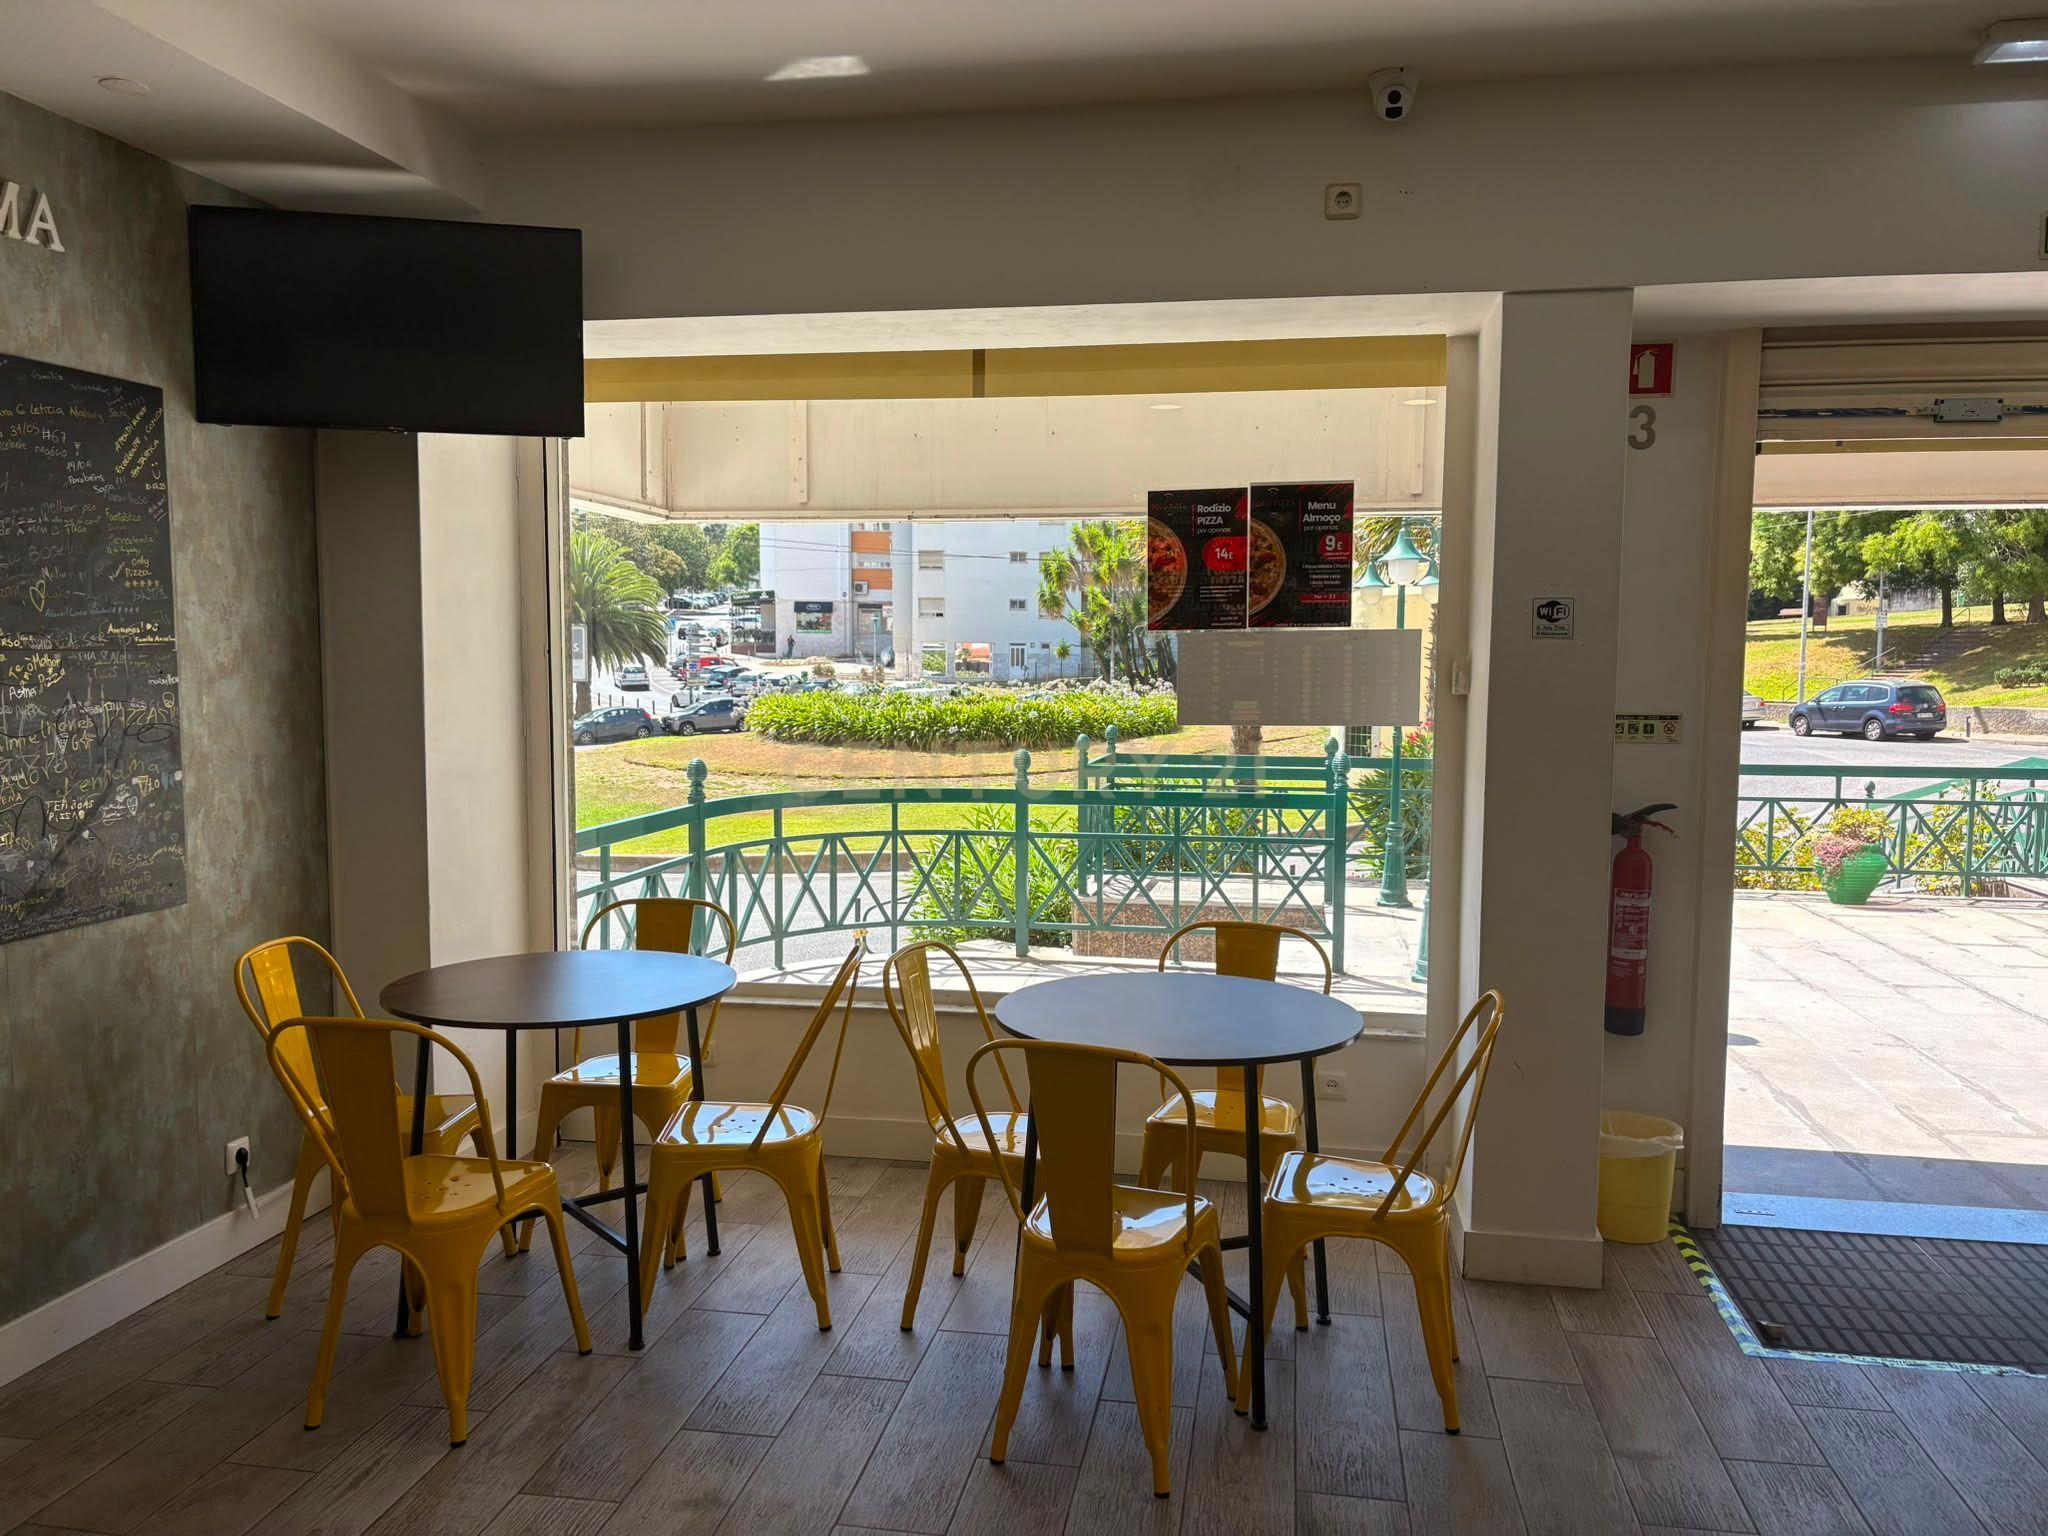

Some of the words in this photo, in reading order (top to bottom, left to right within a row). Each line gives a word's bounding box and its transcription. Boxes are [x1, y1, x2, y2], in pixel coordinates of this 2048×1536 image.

[1627, 405, 1657, 450] 3
[1197, 503, 1232, 513] Rodízio
[1307, 501, 1336, 511] Menu
[1197, 516, 1224, 525] PIZZA
[1302, 514, 1342, 524] Almoço
